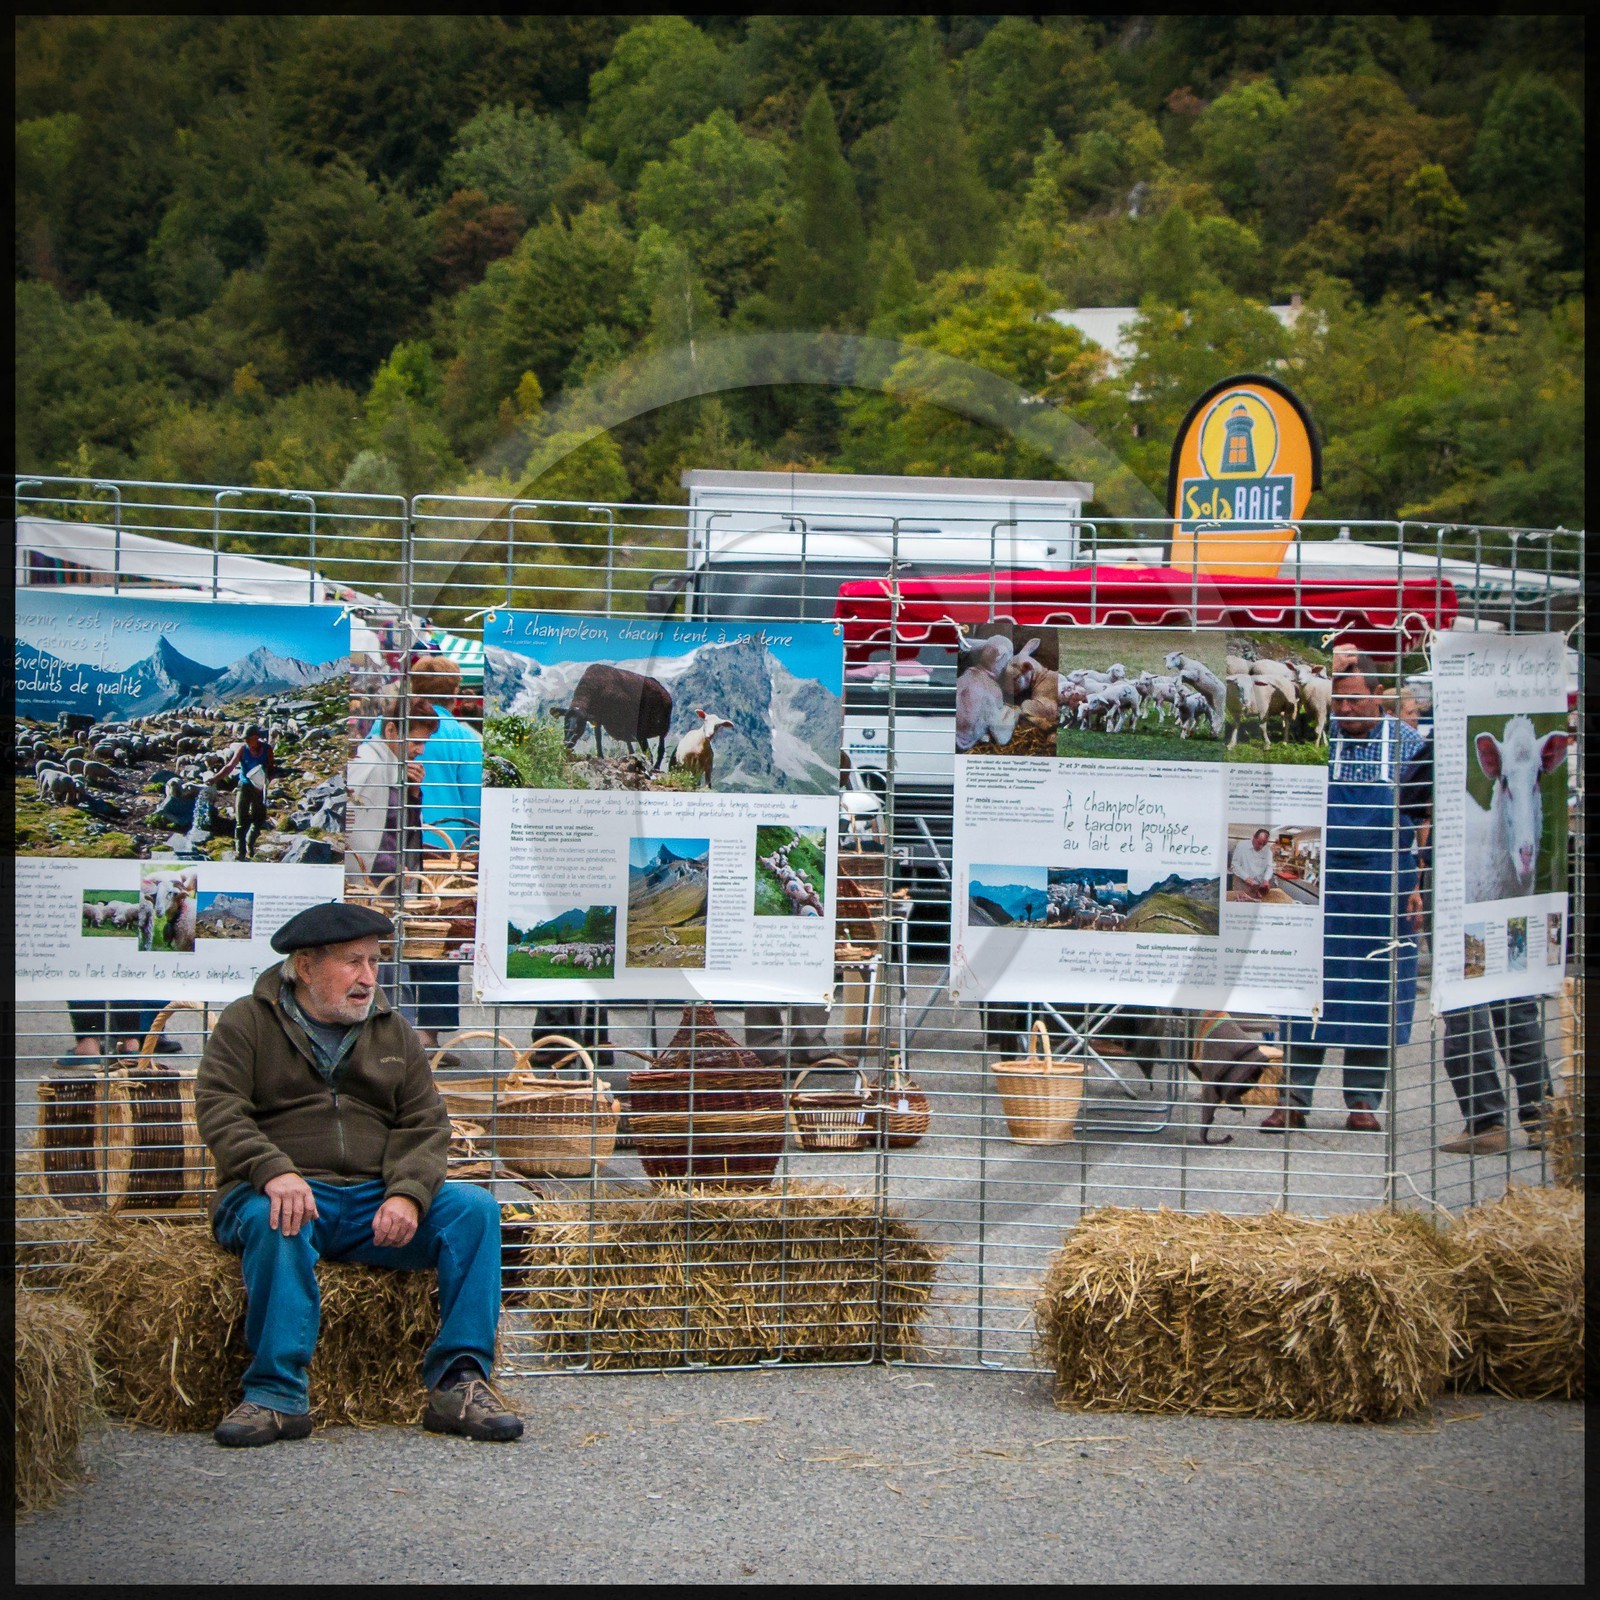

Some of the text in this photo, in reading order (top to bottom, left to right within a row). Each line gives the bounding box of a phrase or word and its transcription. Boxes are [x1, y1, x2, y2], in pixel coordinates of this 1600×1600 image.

[67, 608, 101, 629] c'est
[112, 612, 180, 637] préserver
[525, 616, 609, 643] Champoléon,
[618, 619, 664, 642] chacun
[673, 622, 709, 643] tient
[716, 627, 727, 646] à
[734, 632, 752, 646] sa
[760, 629, 793, 648] terre
[93, 634, 109, 652] et
[91, 650, 120, 674] des
[69, 671, 91, 695] de
[96, 674, 143, 706] qualité
[1062, 789, 1074, 812] À
[1084, 790, 1166, 821] Champoléon,
[1064, 811, 1075, 832] le
[1085, 812, 1132, 833] tardon
[1142, 821, 1189, 840] pousse
[1063, 831, 1212, 857] au lait et à l'herbe.
[1151, 945, 1188, 953] simplement
[1225, 946, 1234, 954] Où
[14, 963, 63, 984] ampoléon
[69, 969, 80, 978] ou
[85, 963, 104, 979] l'art
[112, 963, 147, 979] d'aimer
[152, 963, 165, 979] les
[172, 963, 200, 979] choses
